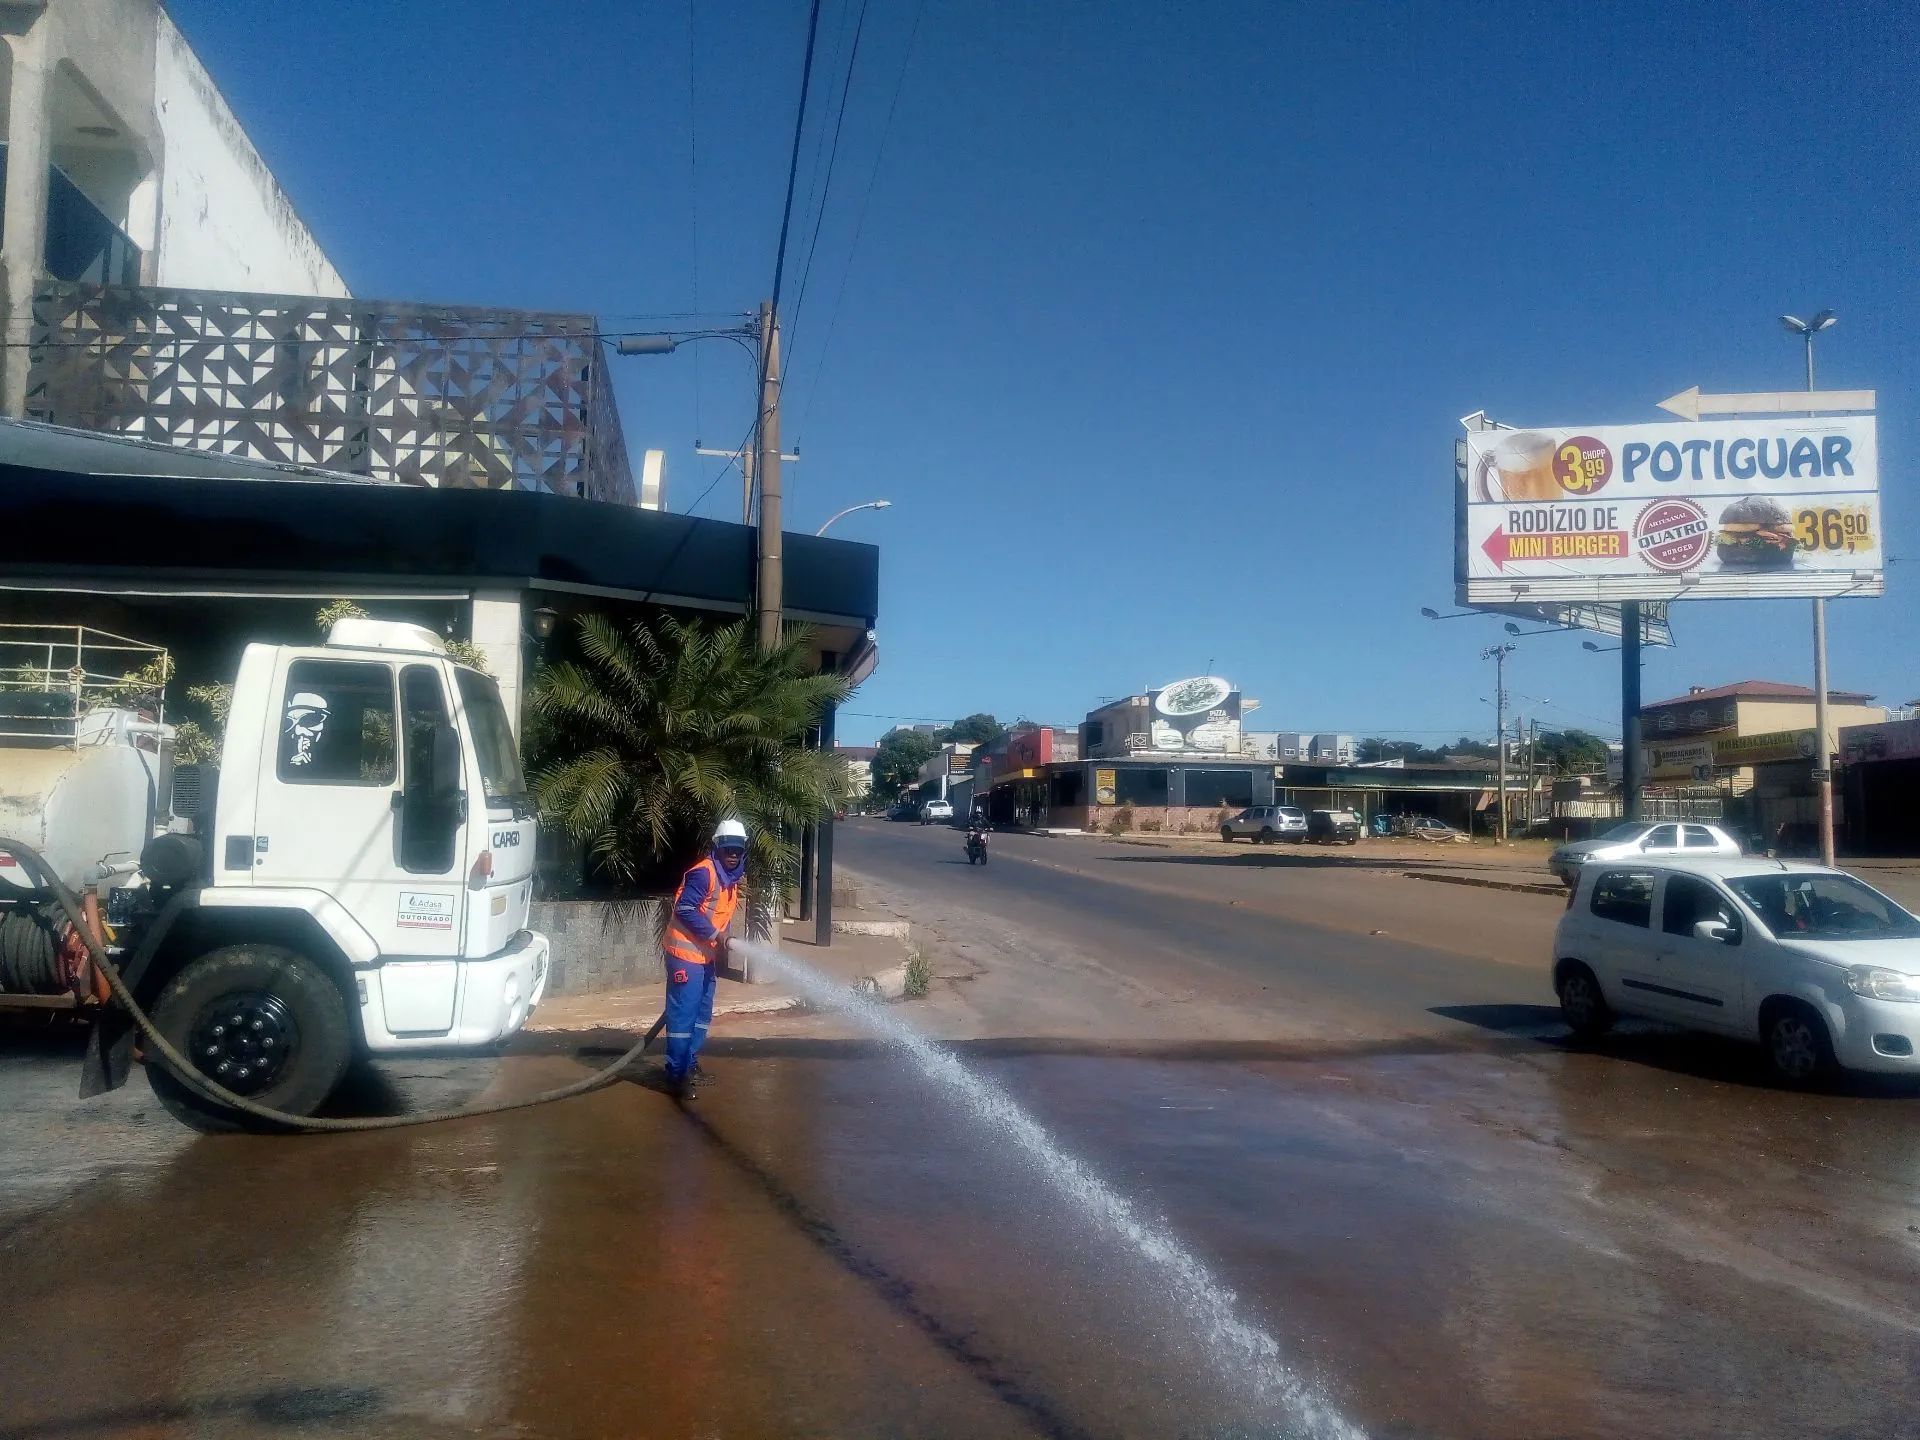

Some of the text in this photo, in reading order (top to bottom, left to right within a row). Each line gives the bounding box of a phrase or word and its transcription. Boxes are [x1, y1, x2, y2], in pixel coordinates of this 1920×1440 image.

[1582, 448, 1606, 460] CHOPP
[1622, 436, 1855, 482] POTIGUAR
[1509, 504, 1618, 533] RODÍZIO DE
[1638, 520, 1708, 549] QUATRO
[1509, 534, 1620, 558] MINI BURGER
[1662, 543, 1694, 557] BURGER
[492, 831, 520, 848] CARGO
[418, 900, 442, 908] Adasa
[400, 914, 450, 922] OUTORGADO
